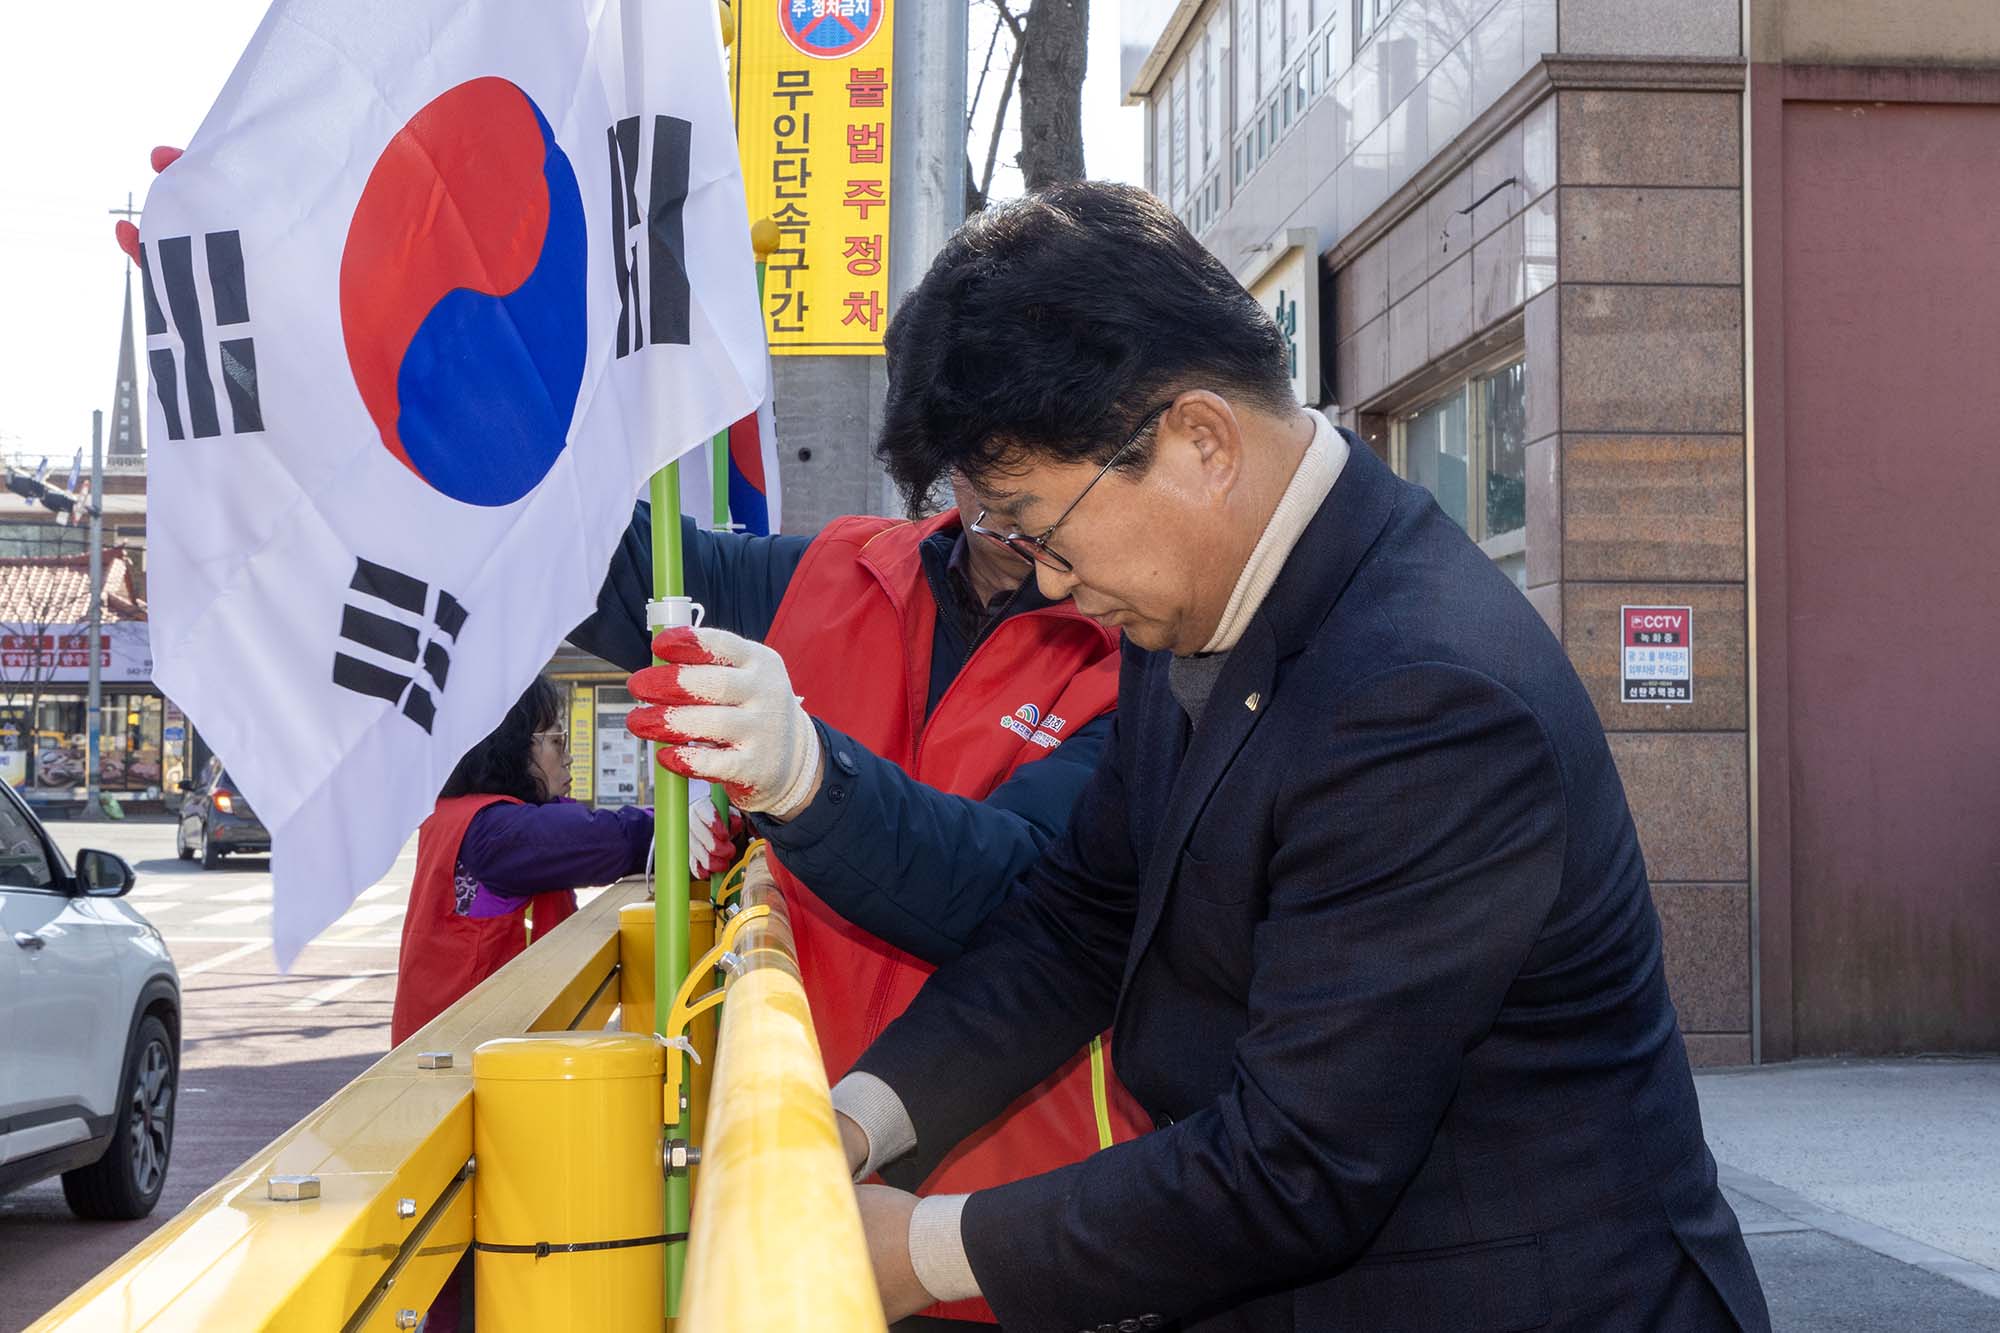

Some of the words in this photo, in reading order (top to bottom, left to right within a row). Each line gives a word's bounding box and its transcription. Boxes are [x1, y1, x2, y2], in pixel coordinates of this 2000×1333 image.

[769, 70, 814, 332] 무인단속구간
[841, 68, 888, 332] 불법주정차
[1643, 615, 1682, 628] CCTV
